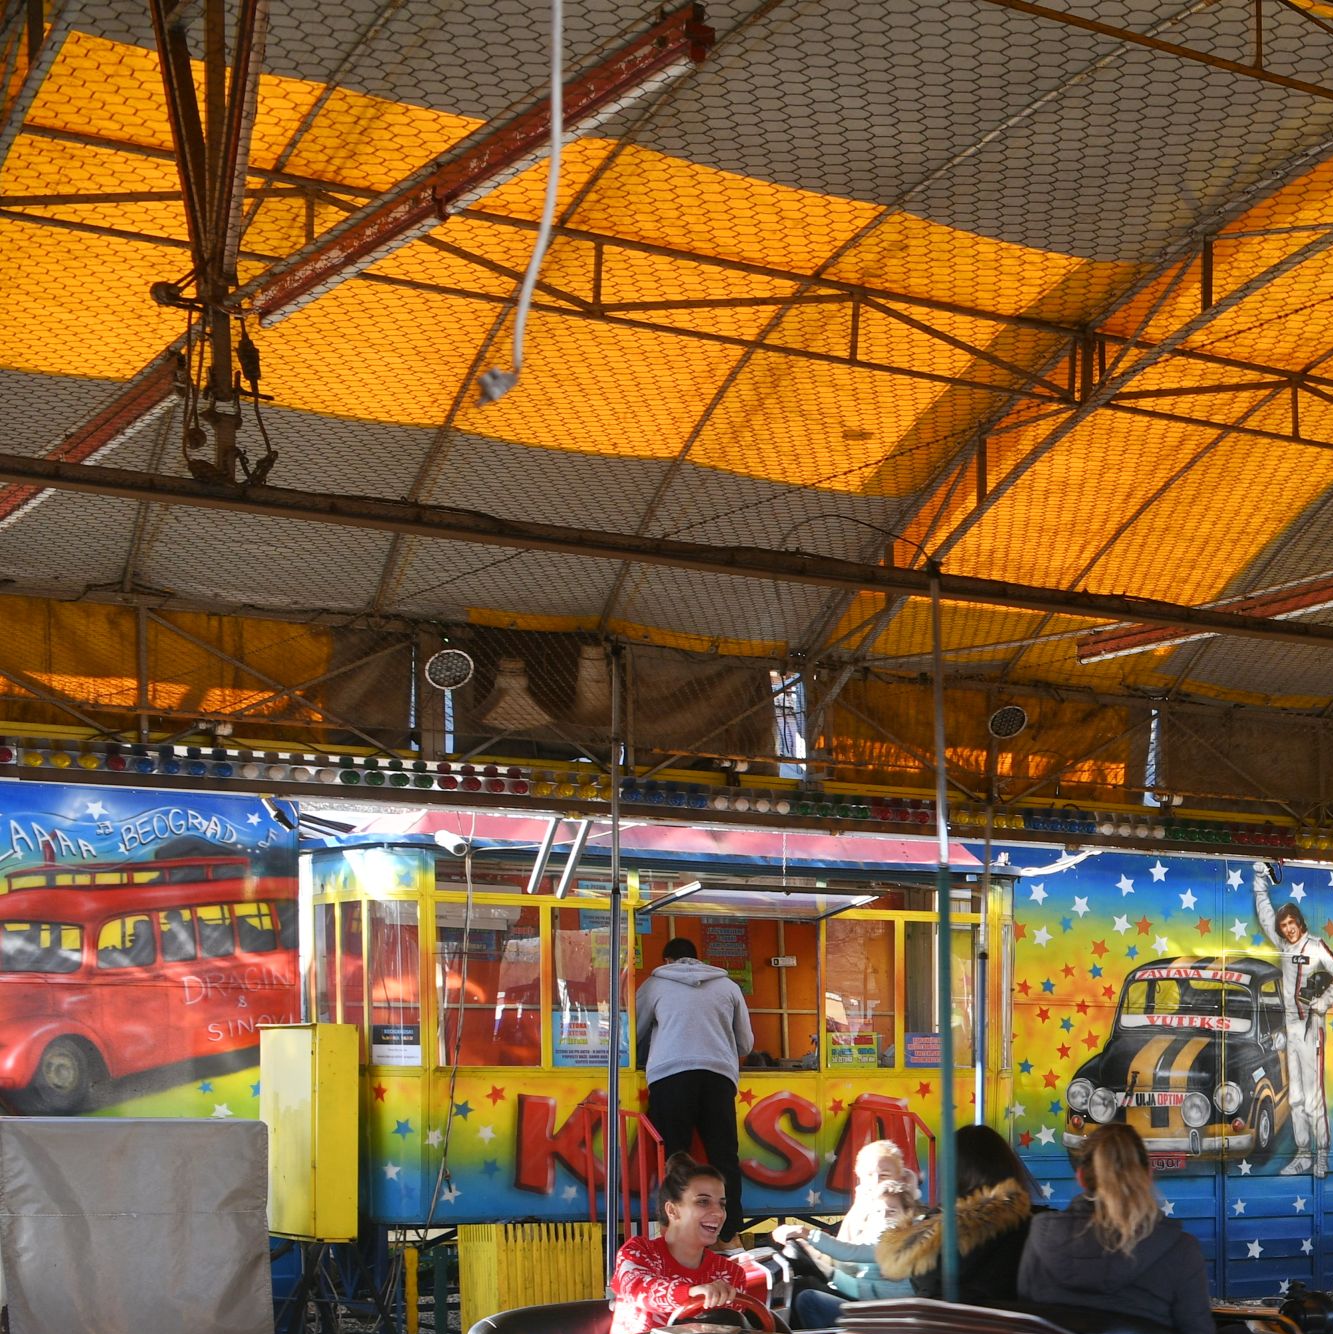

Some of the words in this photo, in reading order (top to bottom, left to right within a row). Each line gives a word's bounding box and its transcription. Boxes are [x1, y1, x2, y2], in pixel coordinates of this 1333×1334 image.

[1146, 1015, 1231, 1030] VUTEKS
[1136, 1093, 1156, 1106] ULJA
[1157, 1093, 1188, 1106] OPTIM
